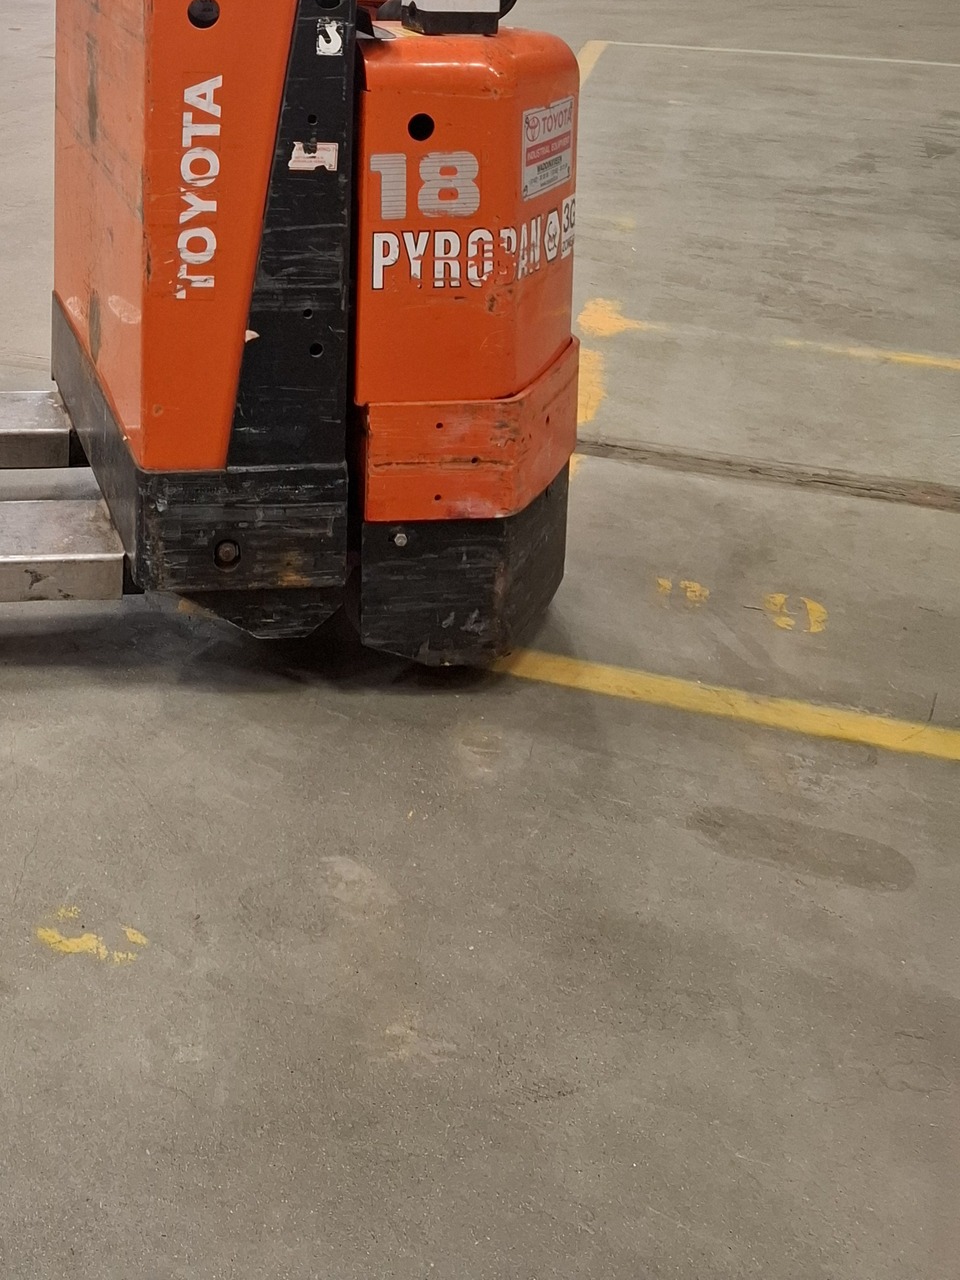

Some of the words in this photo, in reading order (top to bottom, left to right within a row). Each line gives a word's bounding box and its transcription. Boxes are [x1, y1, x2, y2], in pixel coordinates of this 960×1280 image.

[542, 107, 572, 135] TOYOTA
[174, 75, 223, 300] TOYOTA
[369, 150, 481, 220] 18
